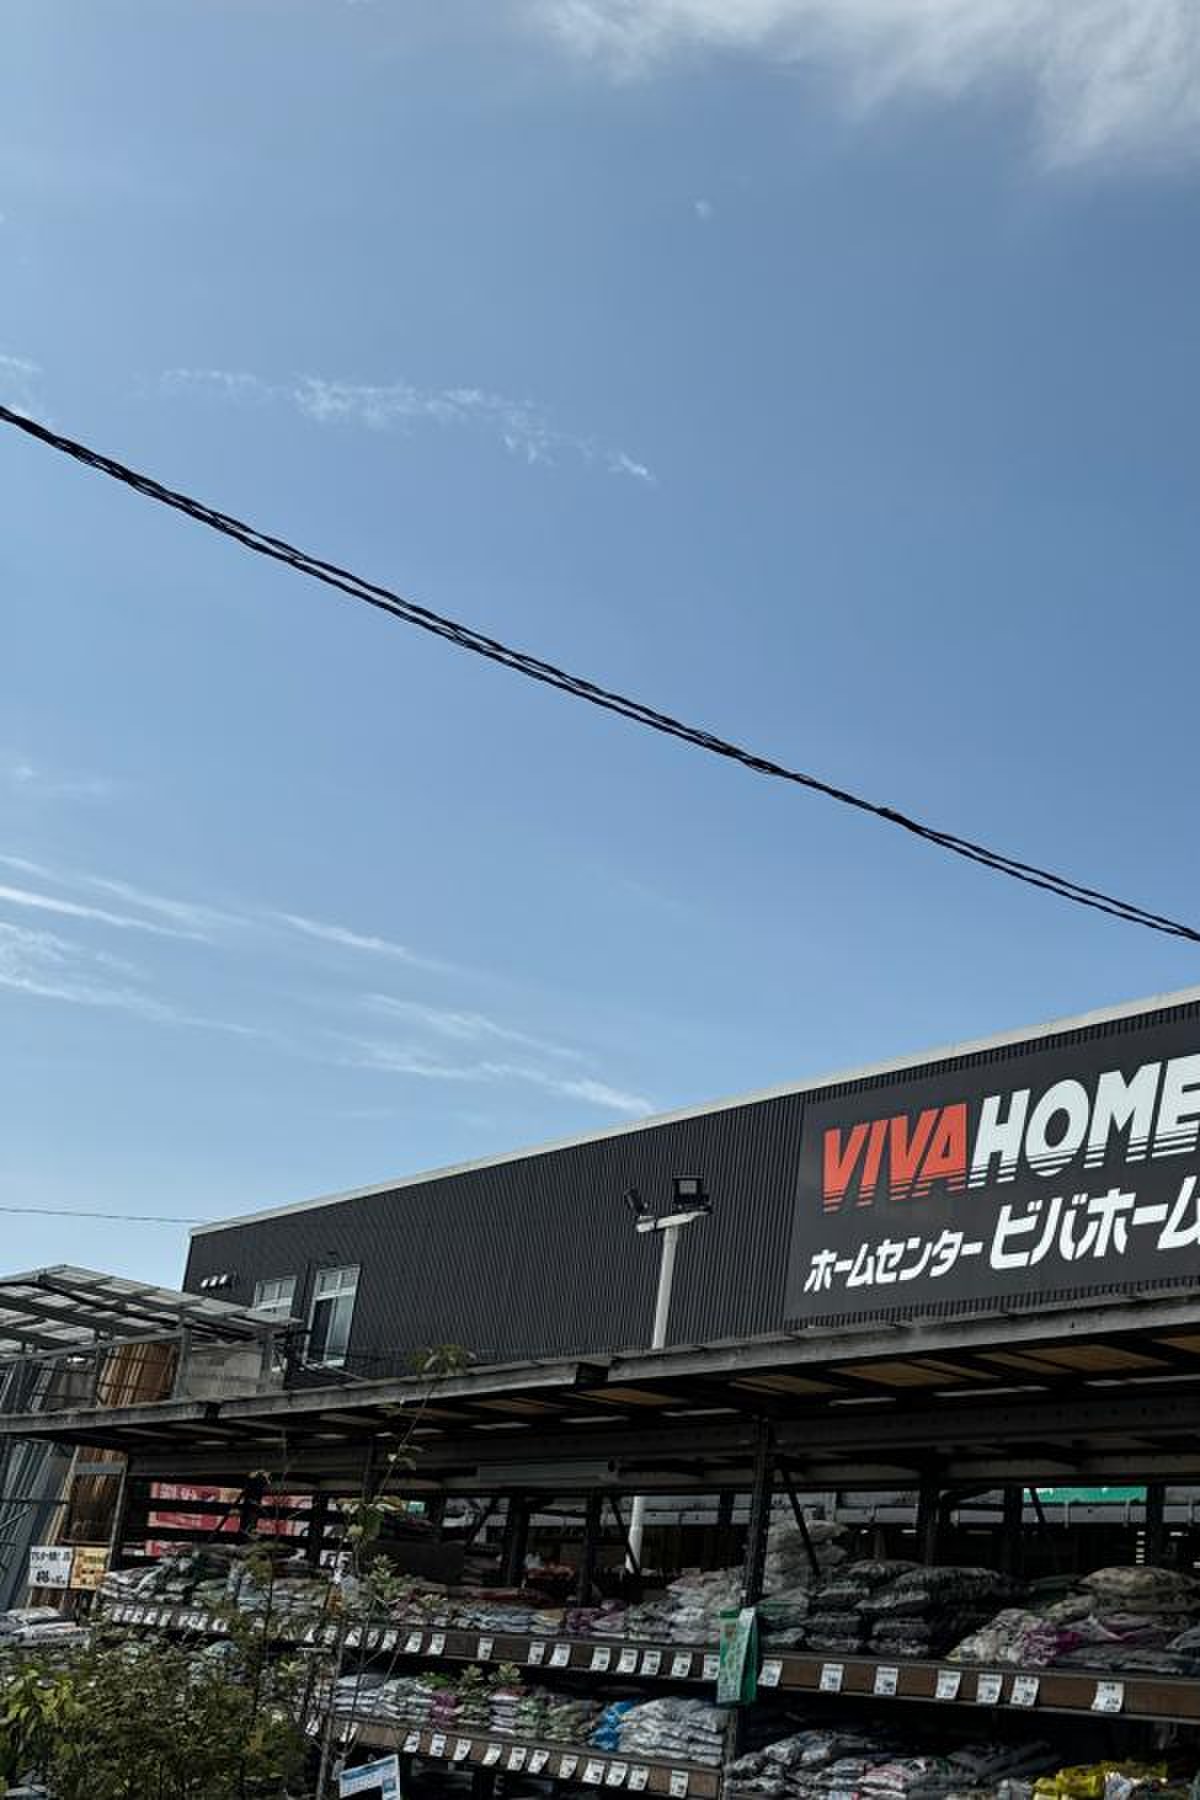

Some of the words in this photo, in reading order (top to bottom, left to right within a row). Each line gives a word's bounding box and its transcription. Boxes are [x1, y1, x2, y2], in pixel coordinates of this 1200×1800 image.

[803, 1228, 984, 1293] ホームセンター
